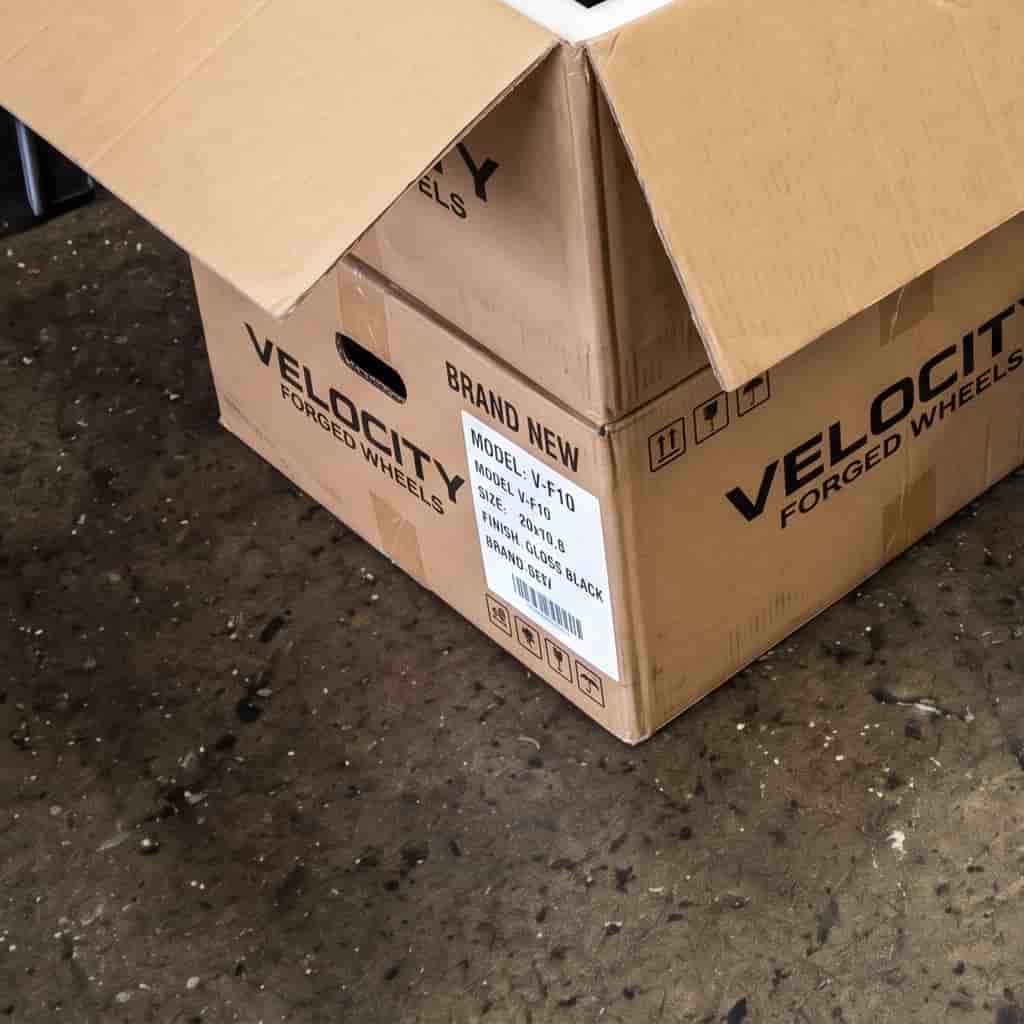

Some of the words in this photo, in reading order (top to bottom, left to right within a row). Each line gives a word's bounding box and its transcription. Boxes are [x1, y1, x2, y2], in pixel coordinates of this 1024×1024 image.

[243, 322, 465, 504] VELOCITY
[280, 383, 357, 450] FORGED
[360, 442, 444, 515] WHEELS
[445, 360, 519, 433] BRAND
[527, 416, 579, 472] NEW
[781, 433, 902, 529] FORGED
[911, 348, 1024, 438] WHEELS
[471, 428, 527, 480] MODEL:
[531, 468, 576, 513] V-F10
[474, 459, 515, 497] MODEL
[518, 488, 552, 521] V-F10
[477, 485, 508, 515] SIZE:
[526, 540, 562, 575] GLOSS
[565, 568, 605, 603] BLACK
